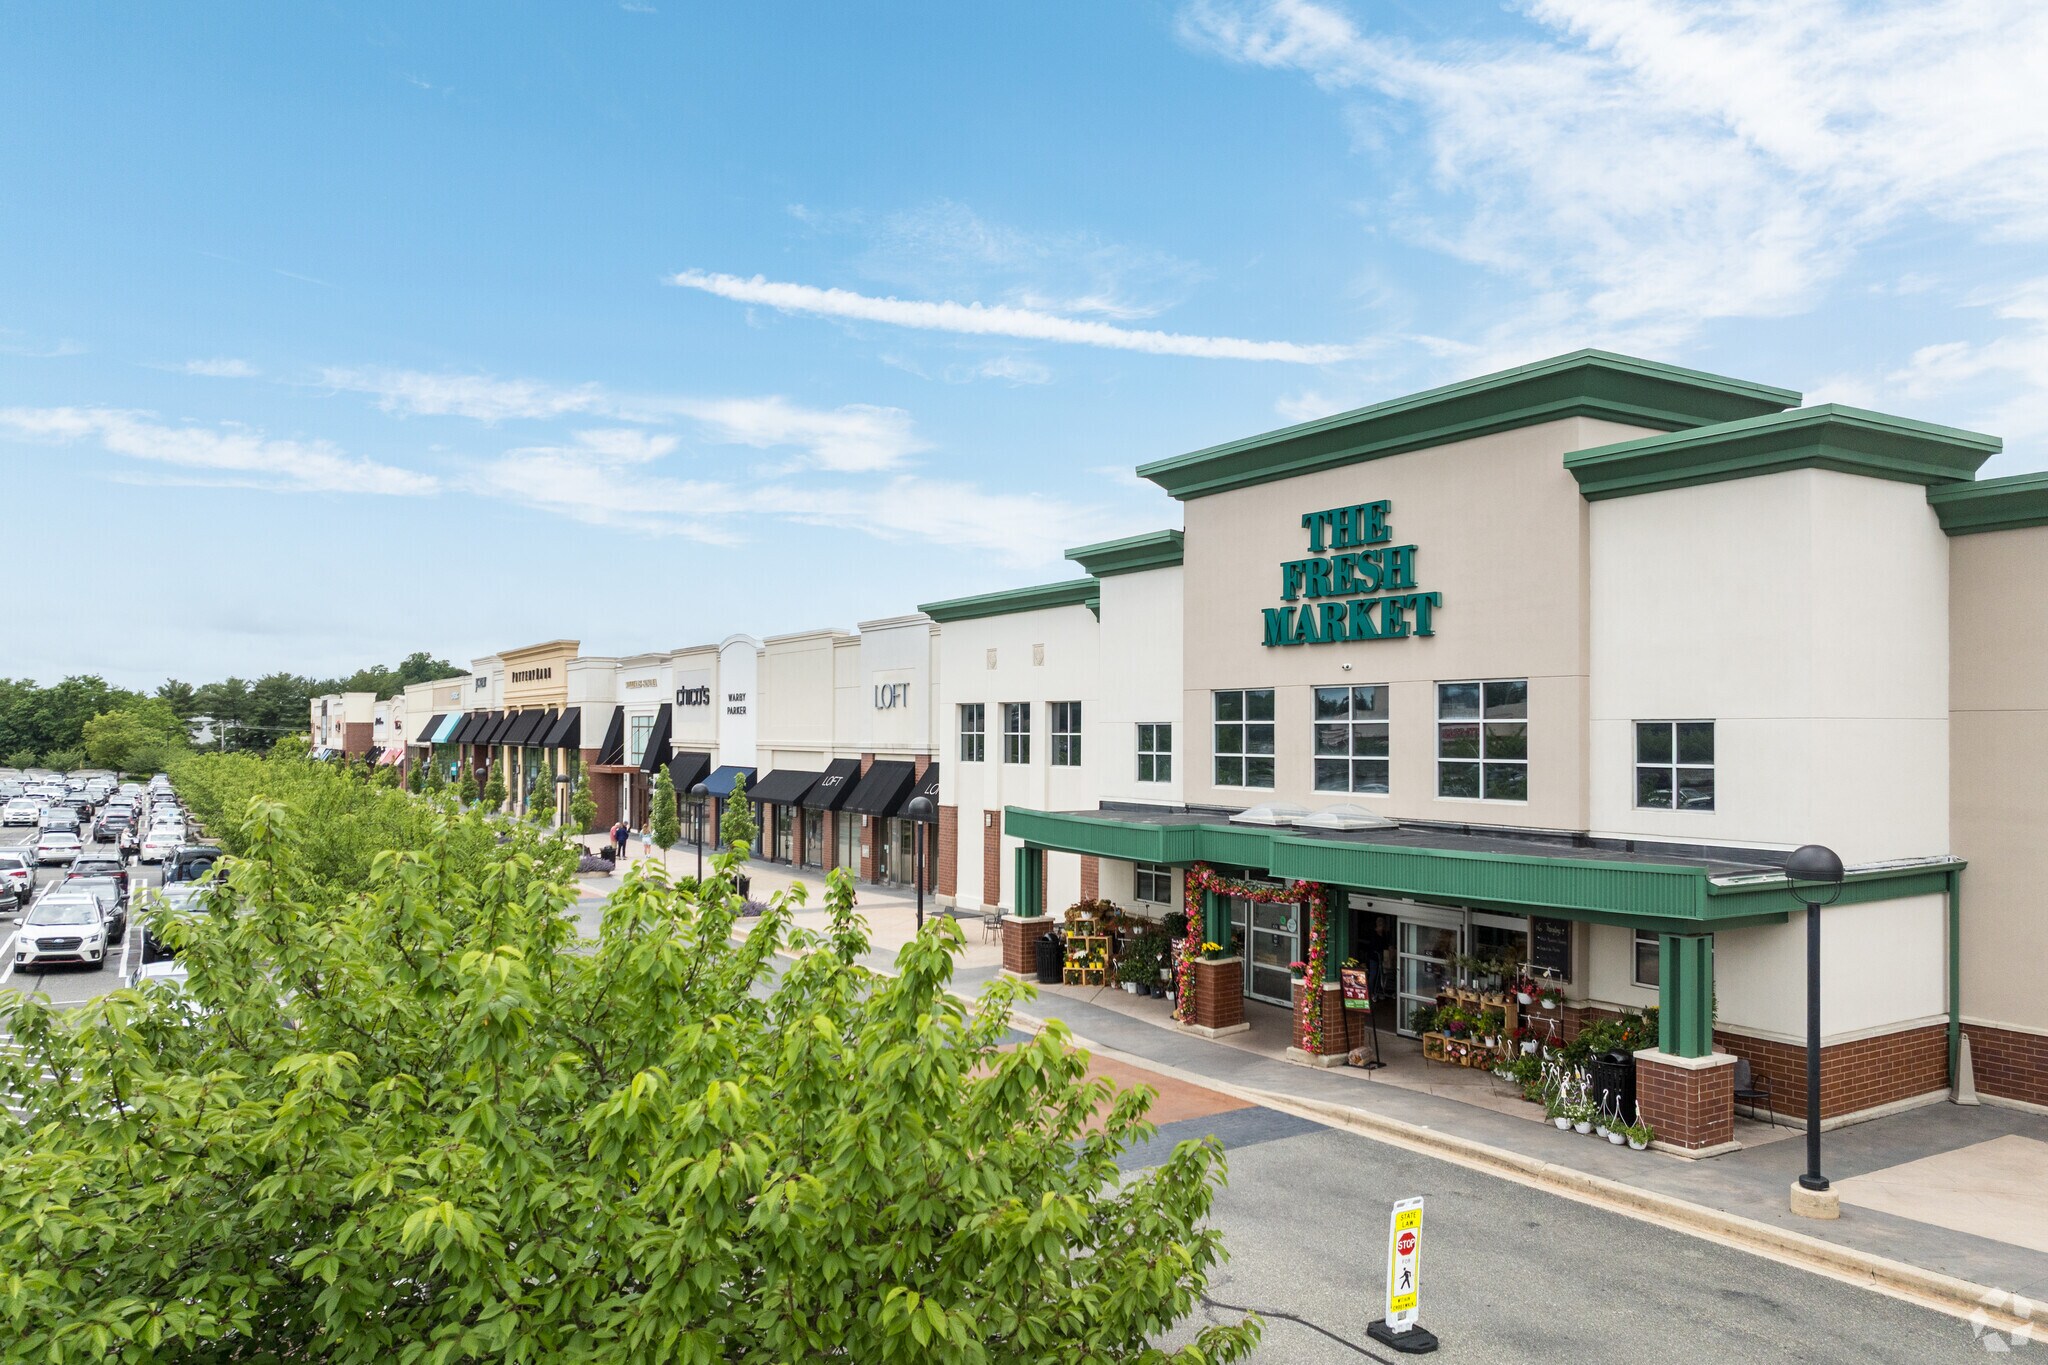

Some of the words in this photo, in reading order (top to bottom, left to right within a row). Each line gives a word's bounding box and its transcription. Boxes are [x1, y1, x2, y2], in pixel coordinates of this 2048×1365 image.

[1302, 500, 1392, 552] THE
[1280, 544, 1418, 601] FRESH
[1261, 591, 1443, 647] MARKET
[728, 693, 746, 702] WARBY
[874, 682, 911, 709] LOFT
[727, 706, 747, 715] PARKER
[822, 776, 843, 786] LOFT
[1400, 1211, 1416, 1220] STATE
[1402, 1220, 1414, 1228] LAW
[1398, 1238, 1415, 1249] STOP
